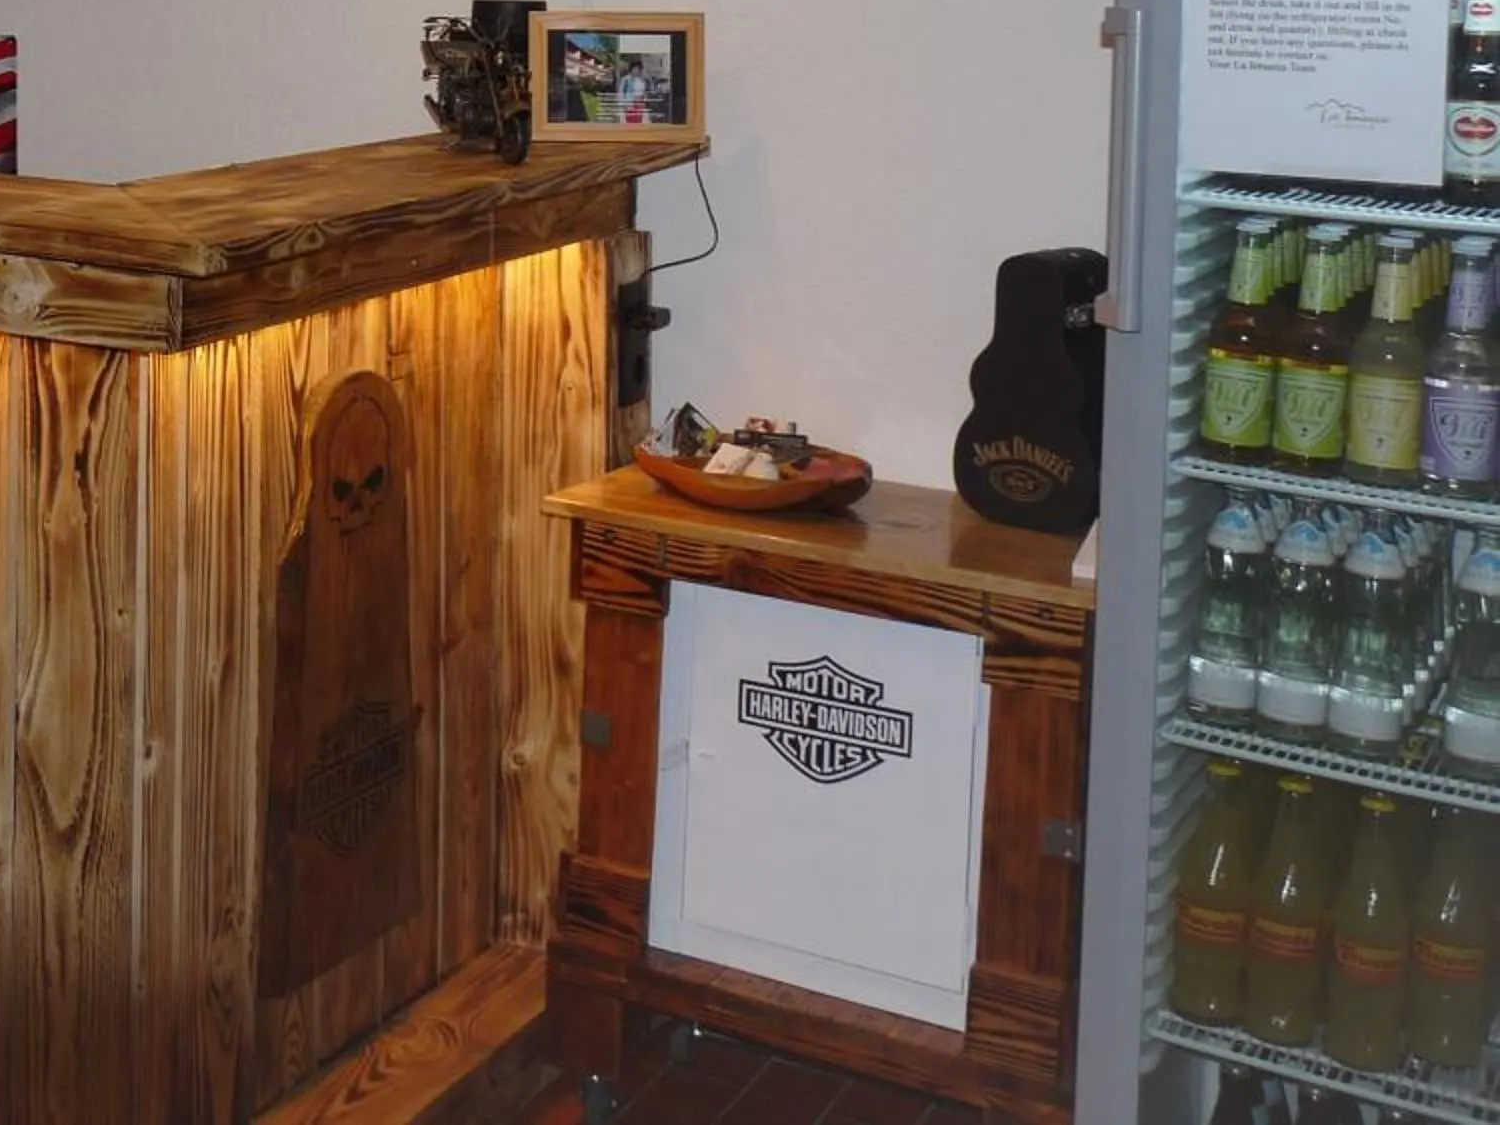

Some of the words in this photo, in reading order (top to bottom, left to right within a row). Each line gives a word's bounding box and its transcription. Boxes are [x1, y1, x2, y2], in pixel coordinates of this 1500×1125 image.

[785, 669, 867, 706] MOTOR
[750, 690, 902, 748] HARLEY-DAVIDSON
[782, 732, 863, 773] CYCLES
